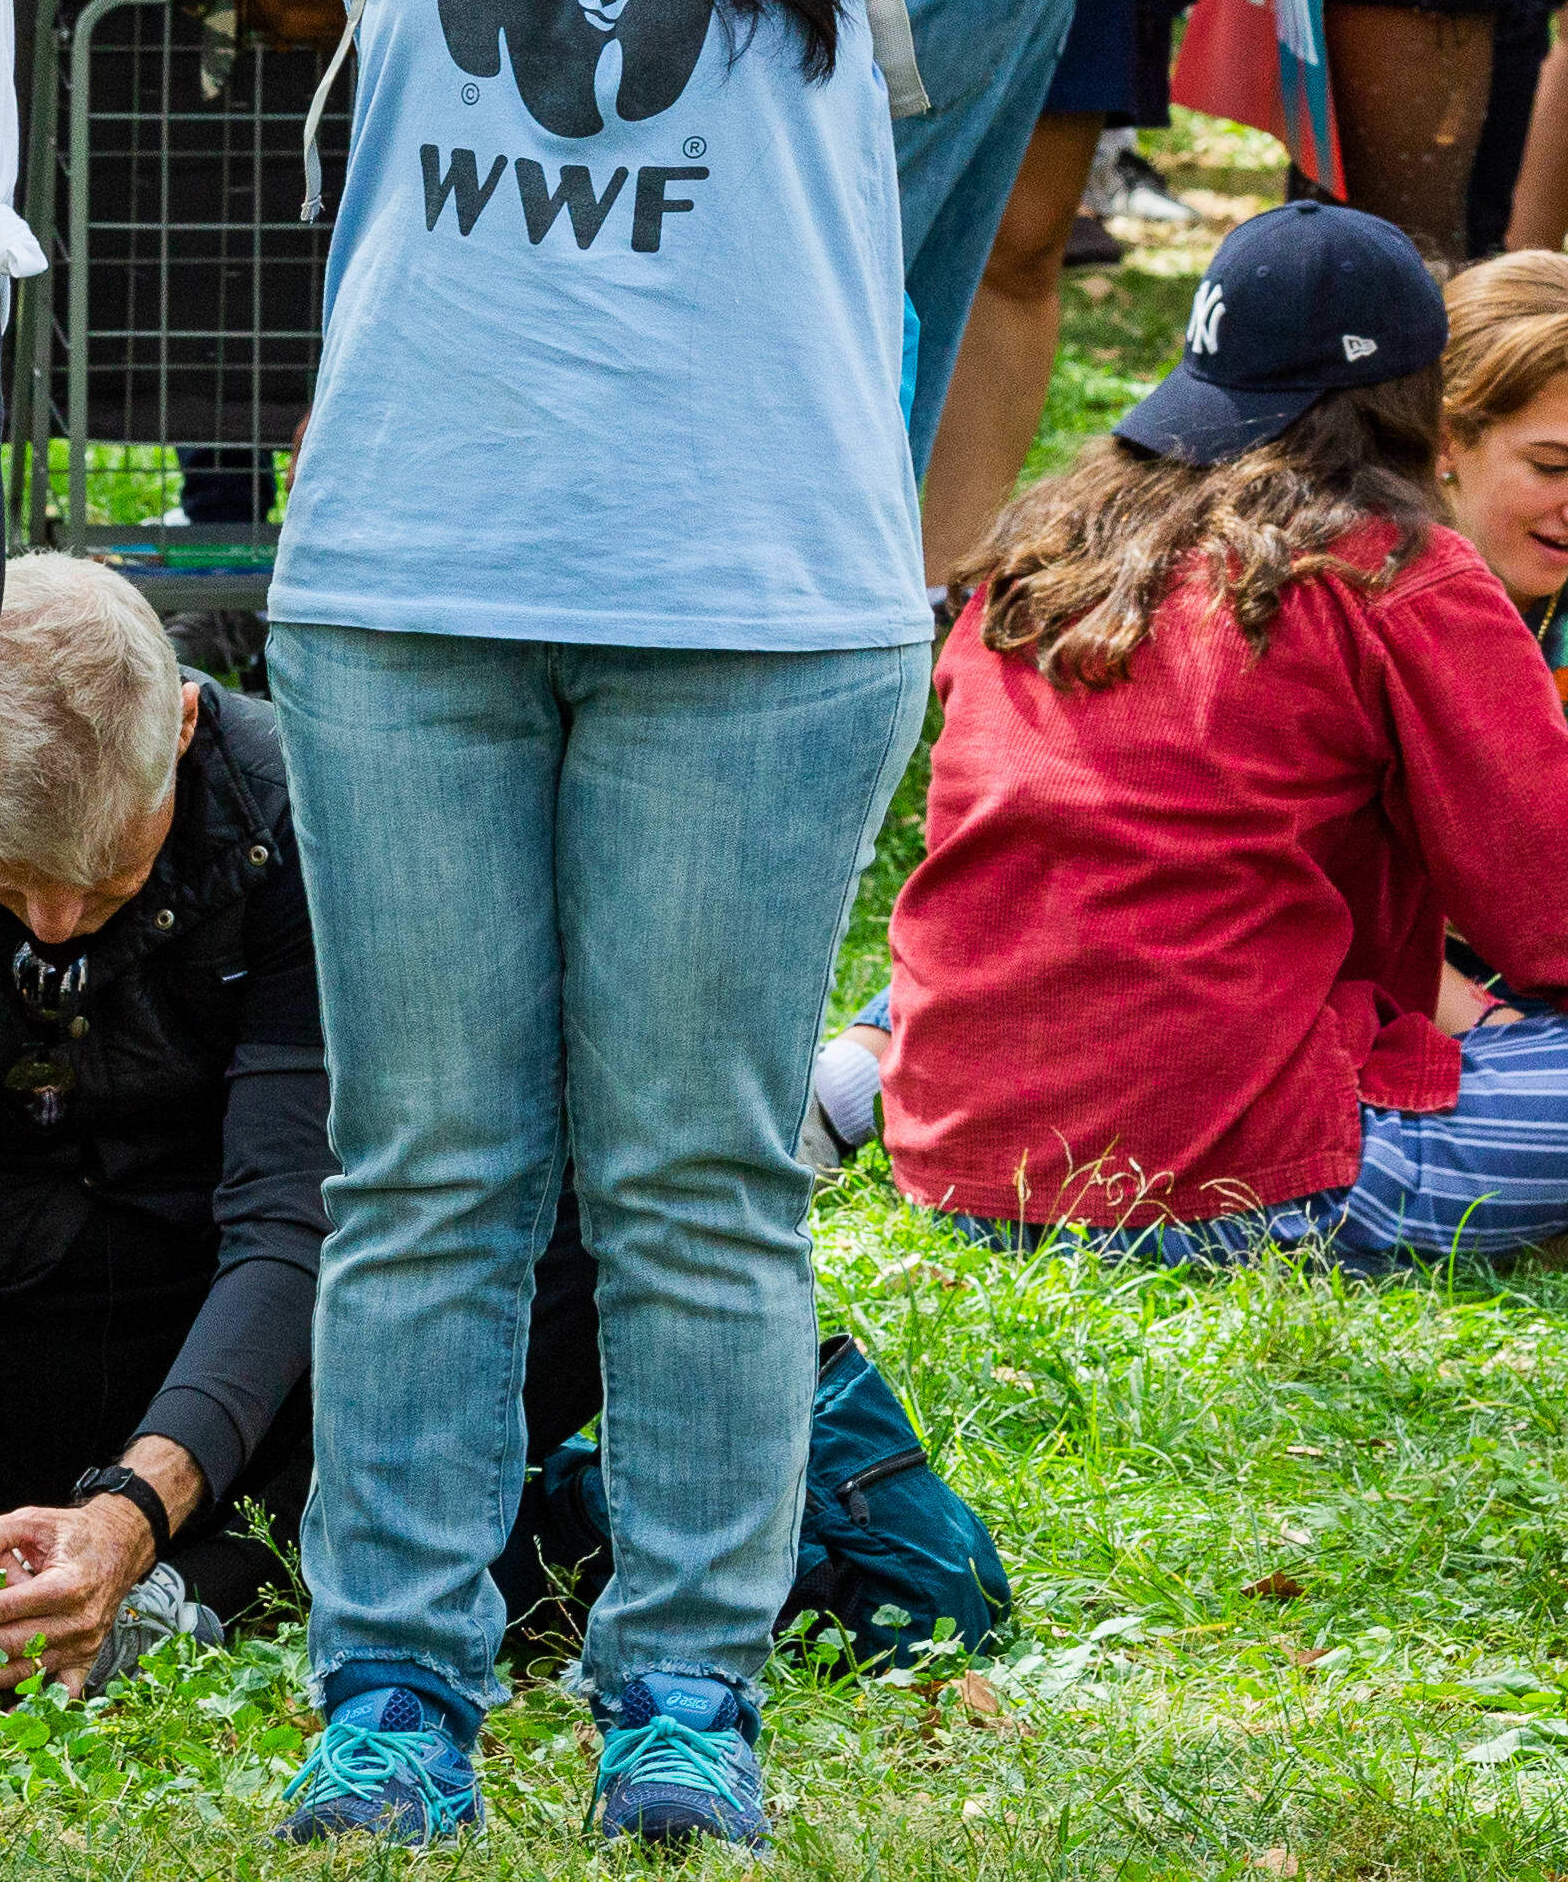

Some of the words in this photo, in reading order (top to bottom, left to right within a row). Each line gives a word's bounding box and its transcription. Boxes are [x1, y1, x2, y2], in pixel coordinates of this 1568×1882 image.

[419, 144, 710, 253] WWF
[1186, 280, 1226, 355] NY
[679, 1695, 710, 1710] asics
